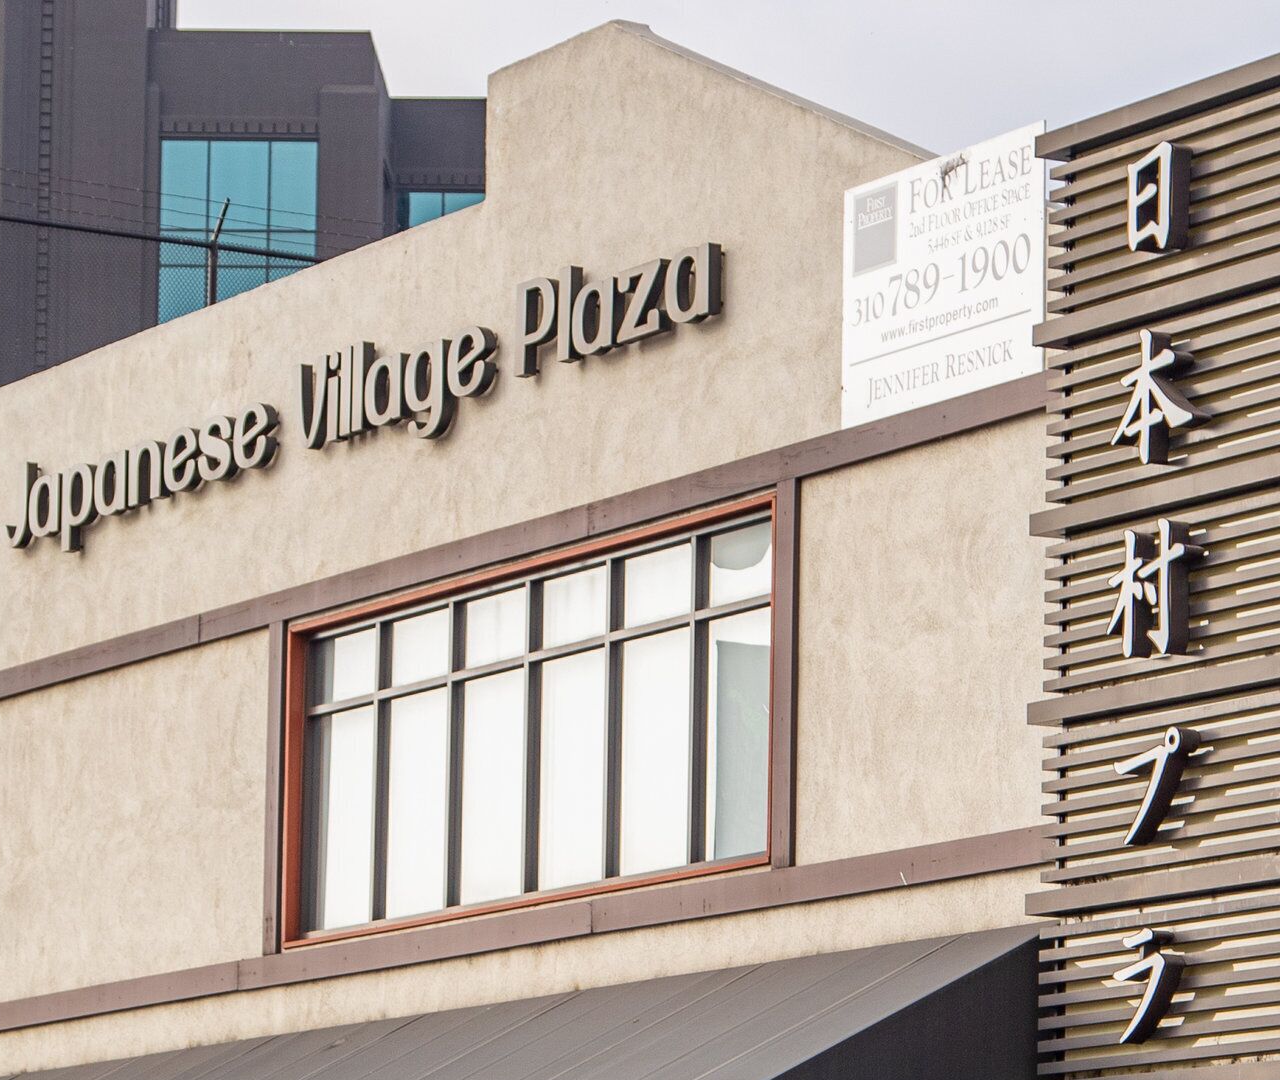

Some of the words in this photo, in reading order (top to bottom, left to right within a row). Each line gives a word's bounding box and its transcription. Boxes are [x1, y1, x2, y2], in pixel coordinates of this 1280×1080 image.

[909, 174, 953, 214] FOR
[963, 145, 1032, 195] LEASE
[928, 207, 960, 232] FLOOR
[963, 194, 1000, 219] OFFICE
[1001, 182, 1032, 207] SPACE
[852, 291, 885, 327] 310
[880, 296, 999, 343] www.firstproperty.com
[6, 403, 280, 552] Japanese
[294, 324, 498, 449] Village
[516, 242, 726, 379] Plaza
[867, 366, 940, 408] JENNIFER
[945, 339, 1014, 380] RESNICK
